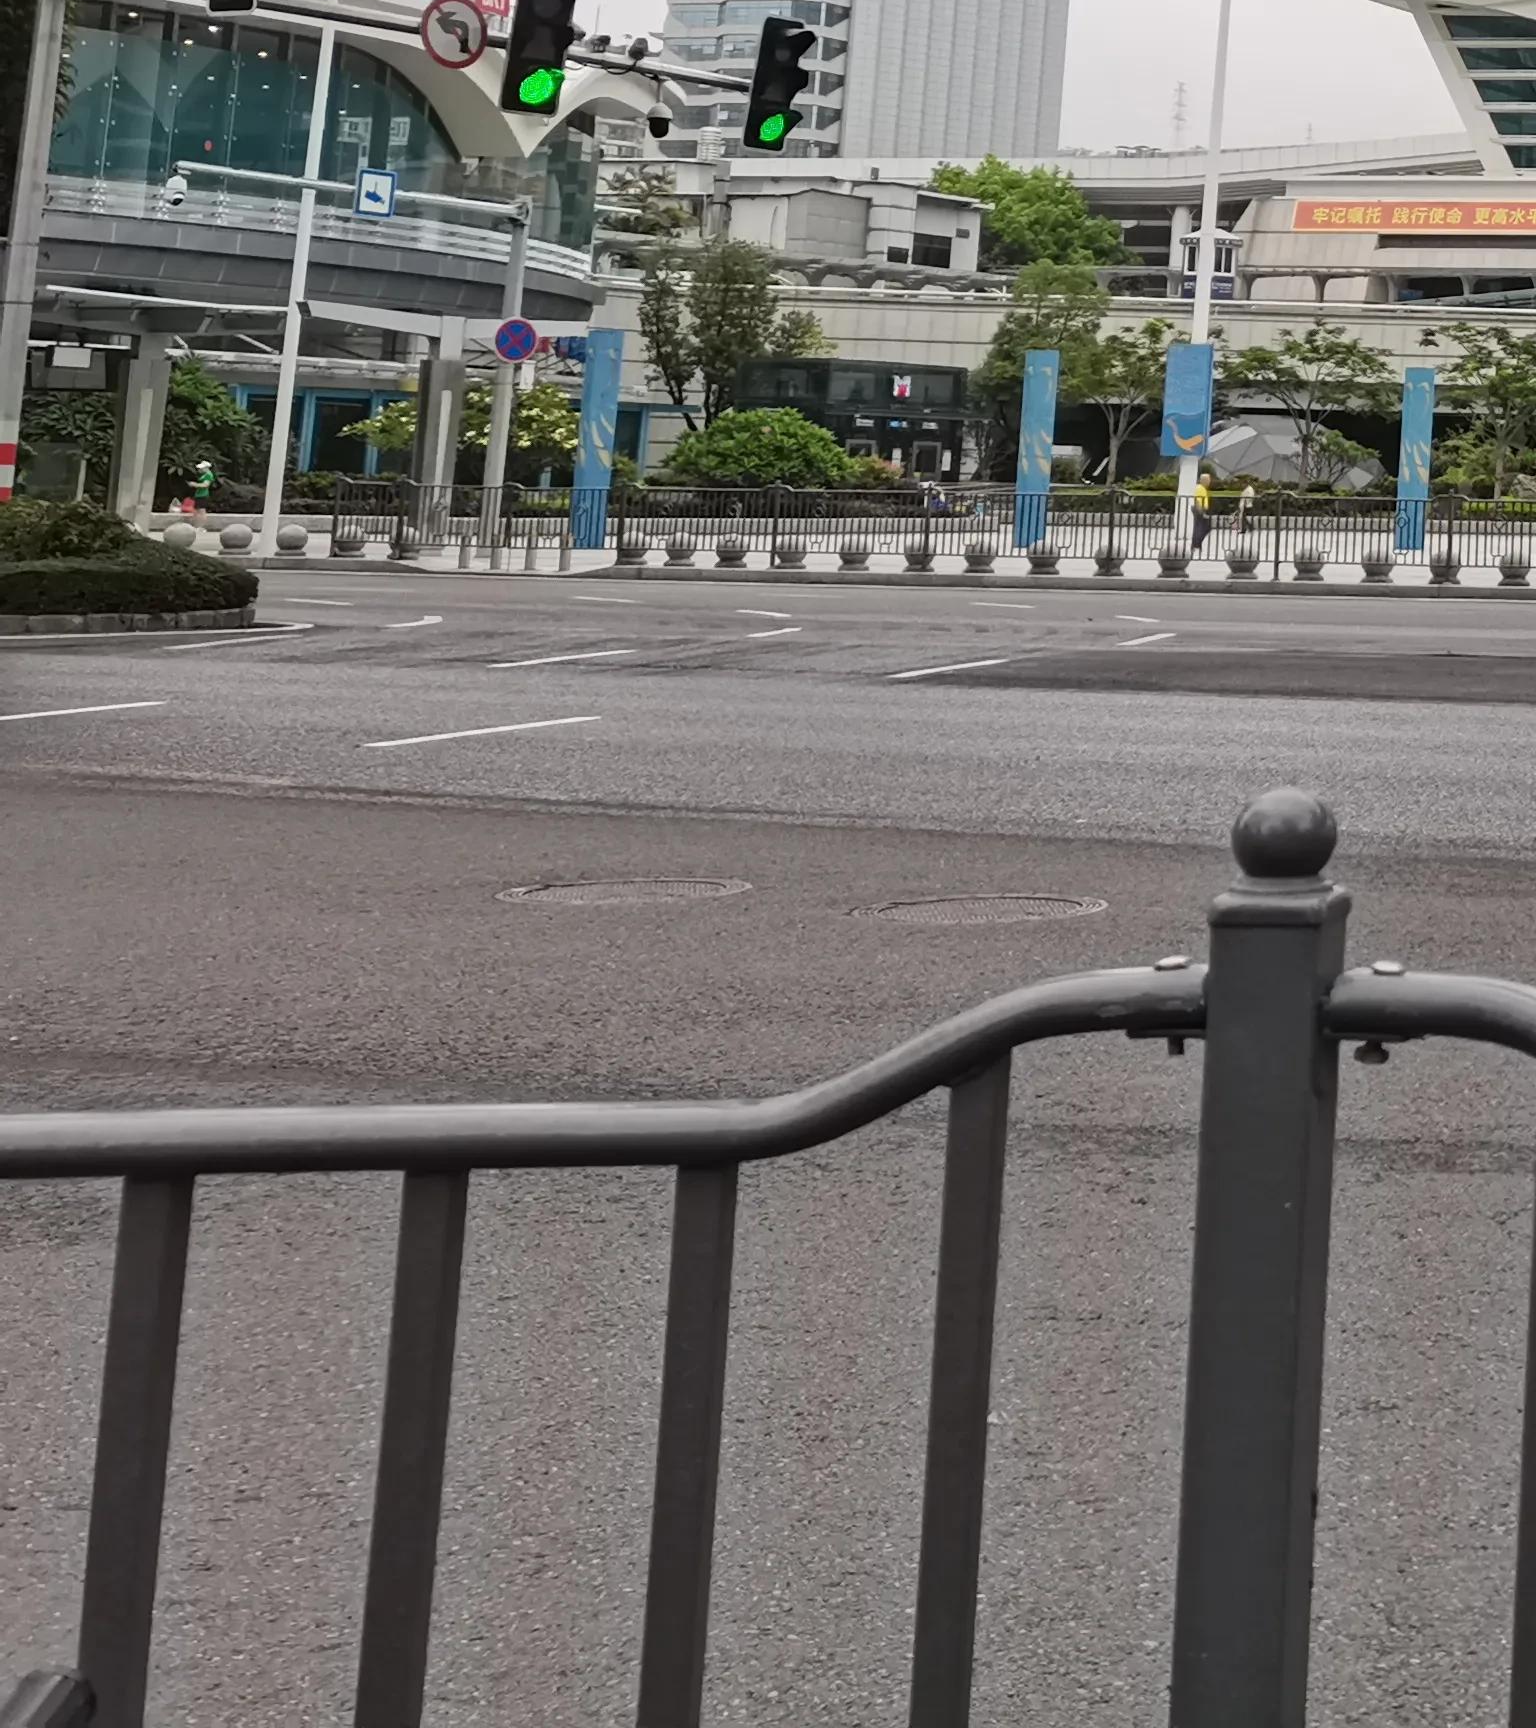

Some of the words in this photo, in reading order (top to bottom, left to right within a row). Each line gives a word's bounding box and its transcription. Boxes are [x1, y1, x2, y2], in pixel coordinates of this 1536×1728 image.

[1311, 206, 1382, 226] 牢记嘱托
[1391, 207, 1463, 225] 践行使命
